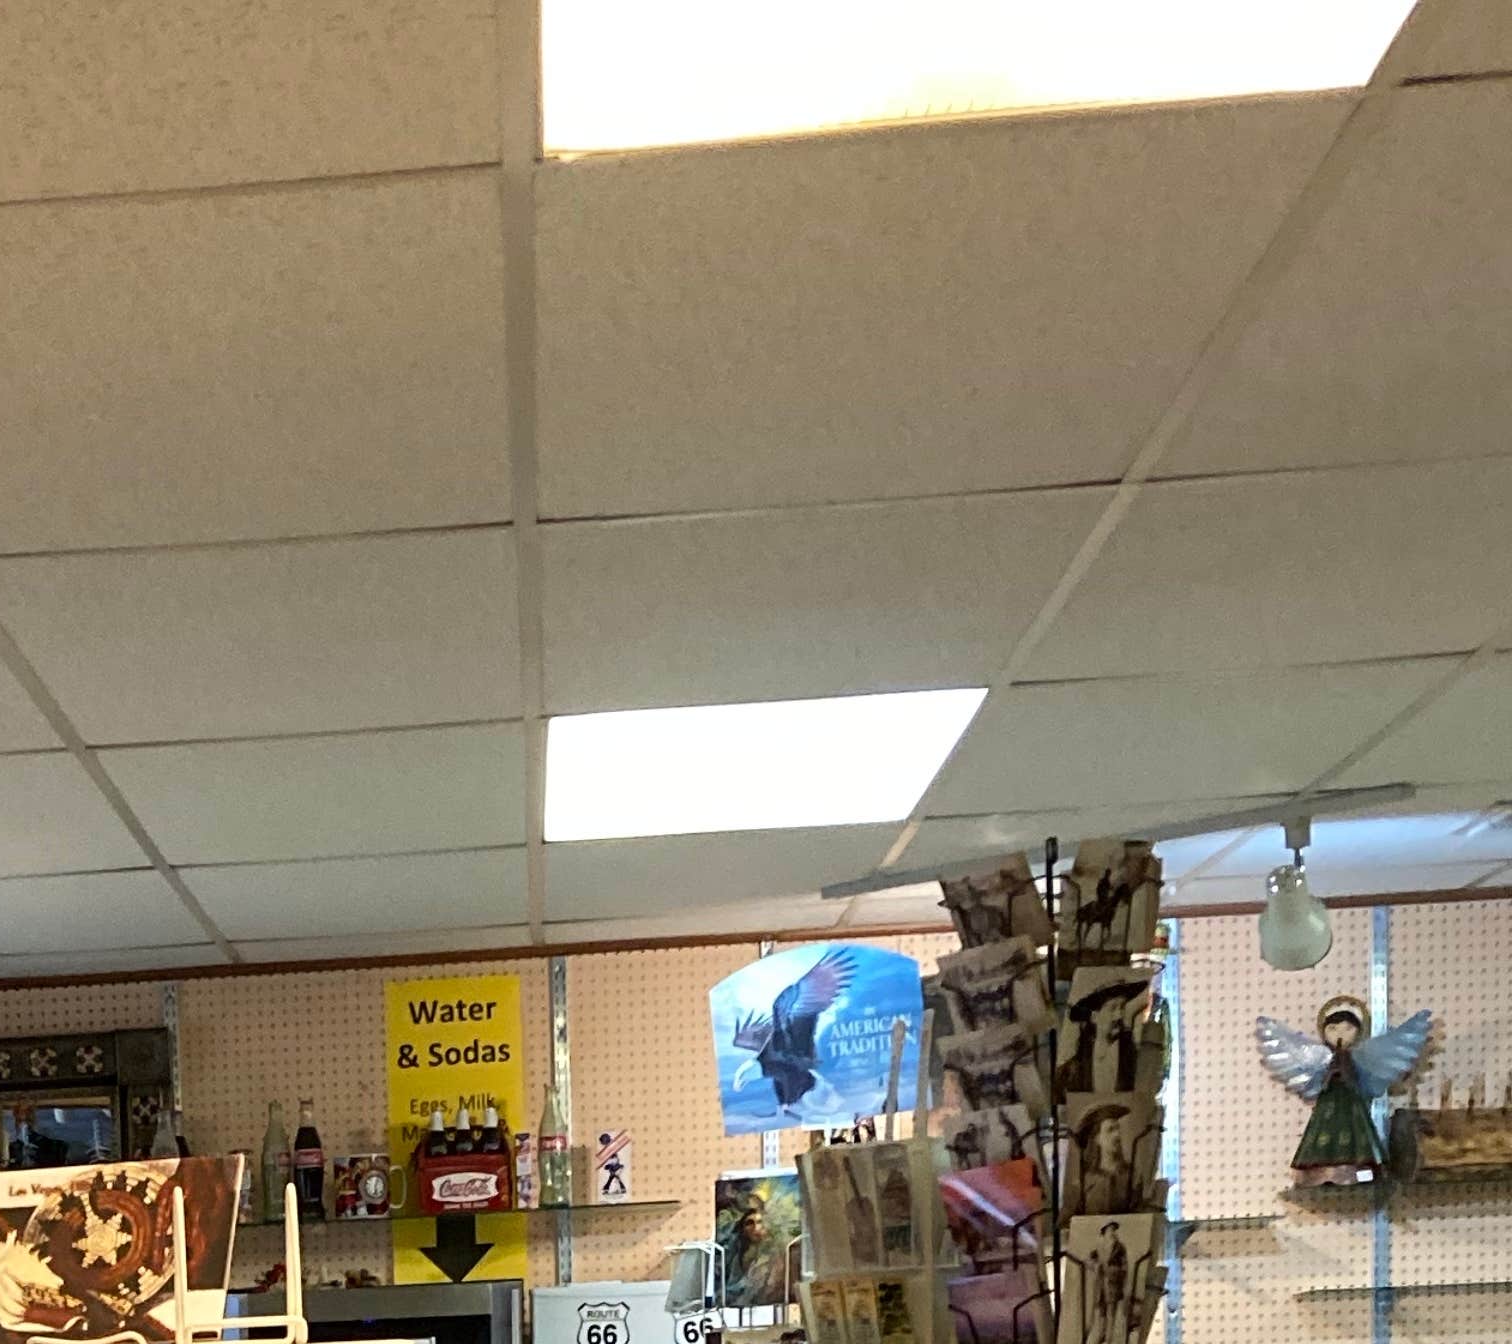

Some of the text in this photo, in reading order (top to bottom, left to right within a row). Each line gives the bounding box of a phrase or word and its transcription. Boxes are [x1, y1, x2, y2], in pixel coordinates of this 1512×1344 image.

[409, 999, 497, 1025] Water
[397, 1038, 511, 1069] & Sodas
[830, 1030, 918, 1058] TRADITIN
[409, 1093, 502, 1118] Eggs, Milk,
[587, 1310, 620, 1319] ROUTE
